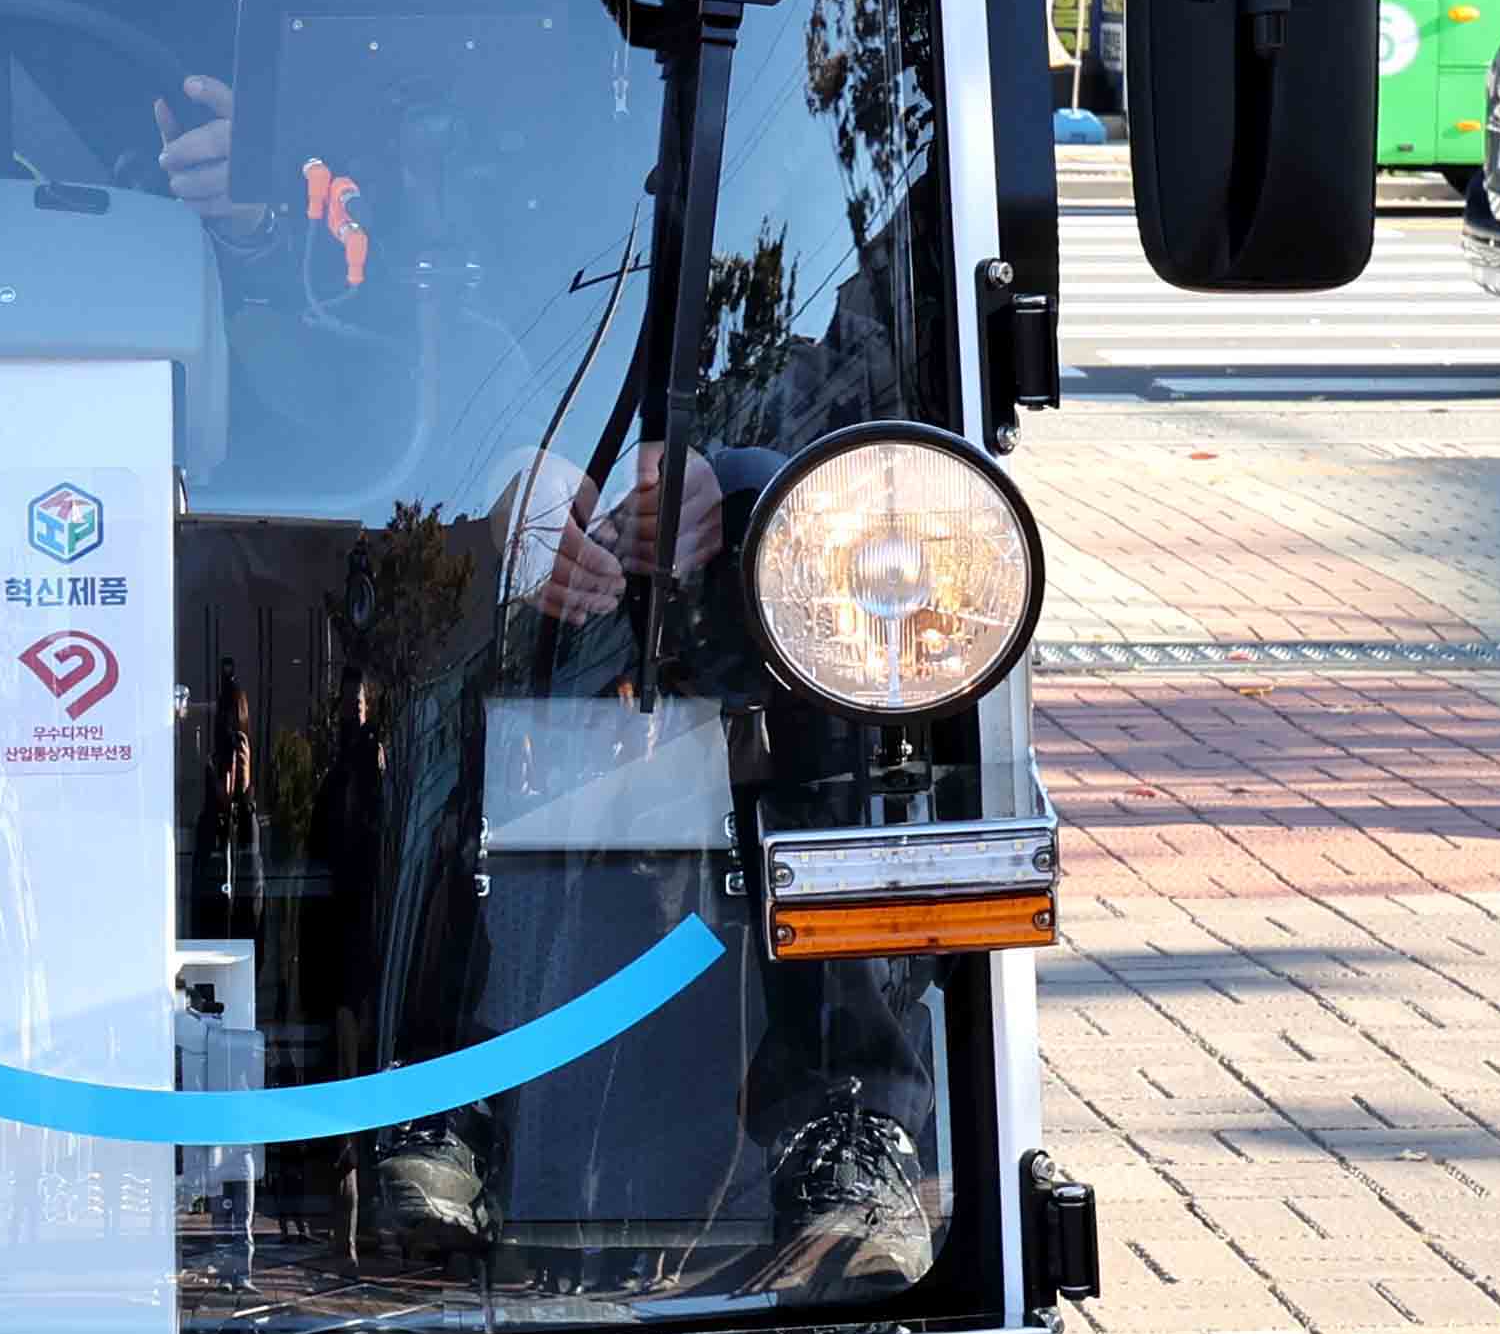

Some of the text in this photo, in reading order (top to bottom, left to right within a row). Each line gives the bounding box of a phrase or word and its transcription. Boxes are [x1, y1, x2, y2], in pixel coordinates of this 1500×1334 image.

[4, 576, 129, 608] 혁신제품
[32, 725, 105, 741] 우수디자인
[5, 745, 133, 763] 산업통상자원부선정
